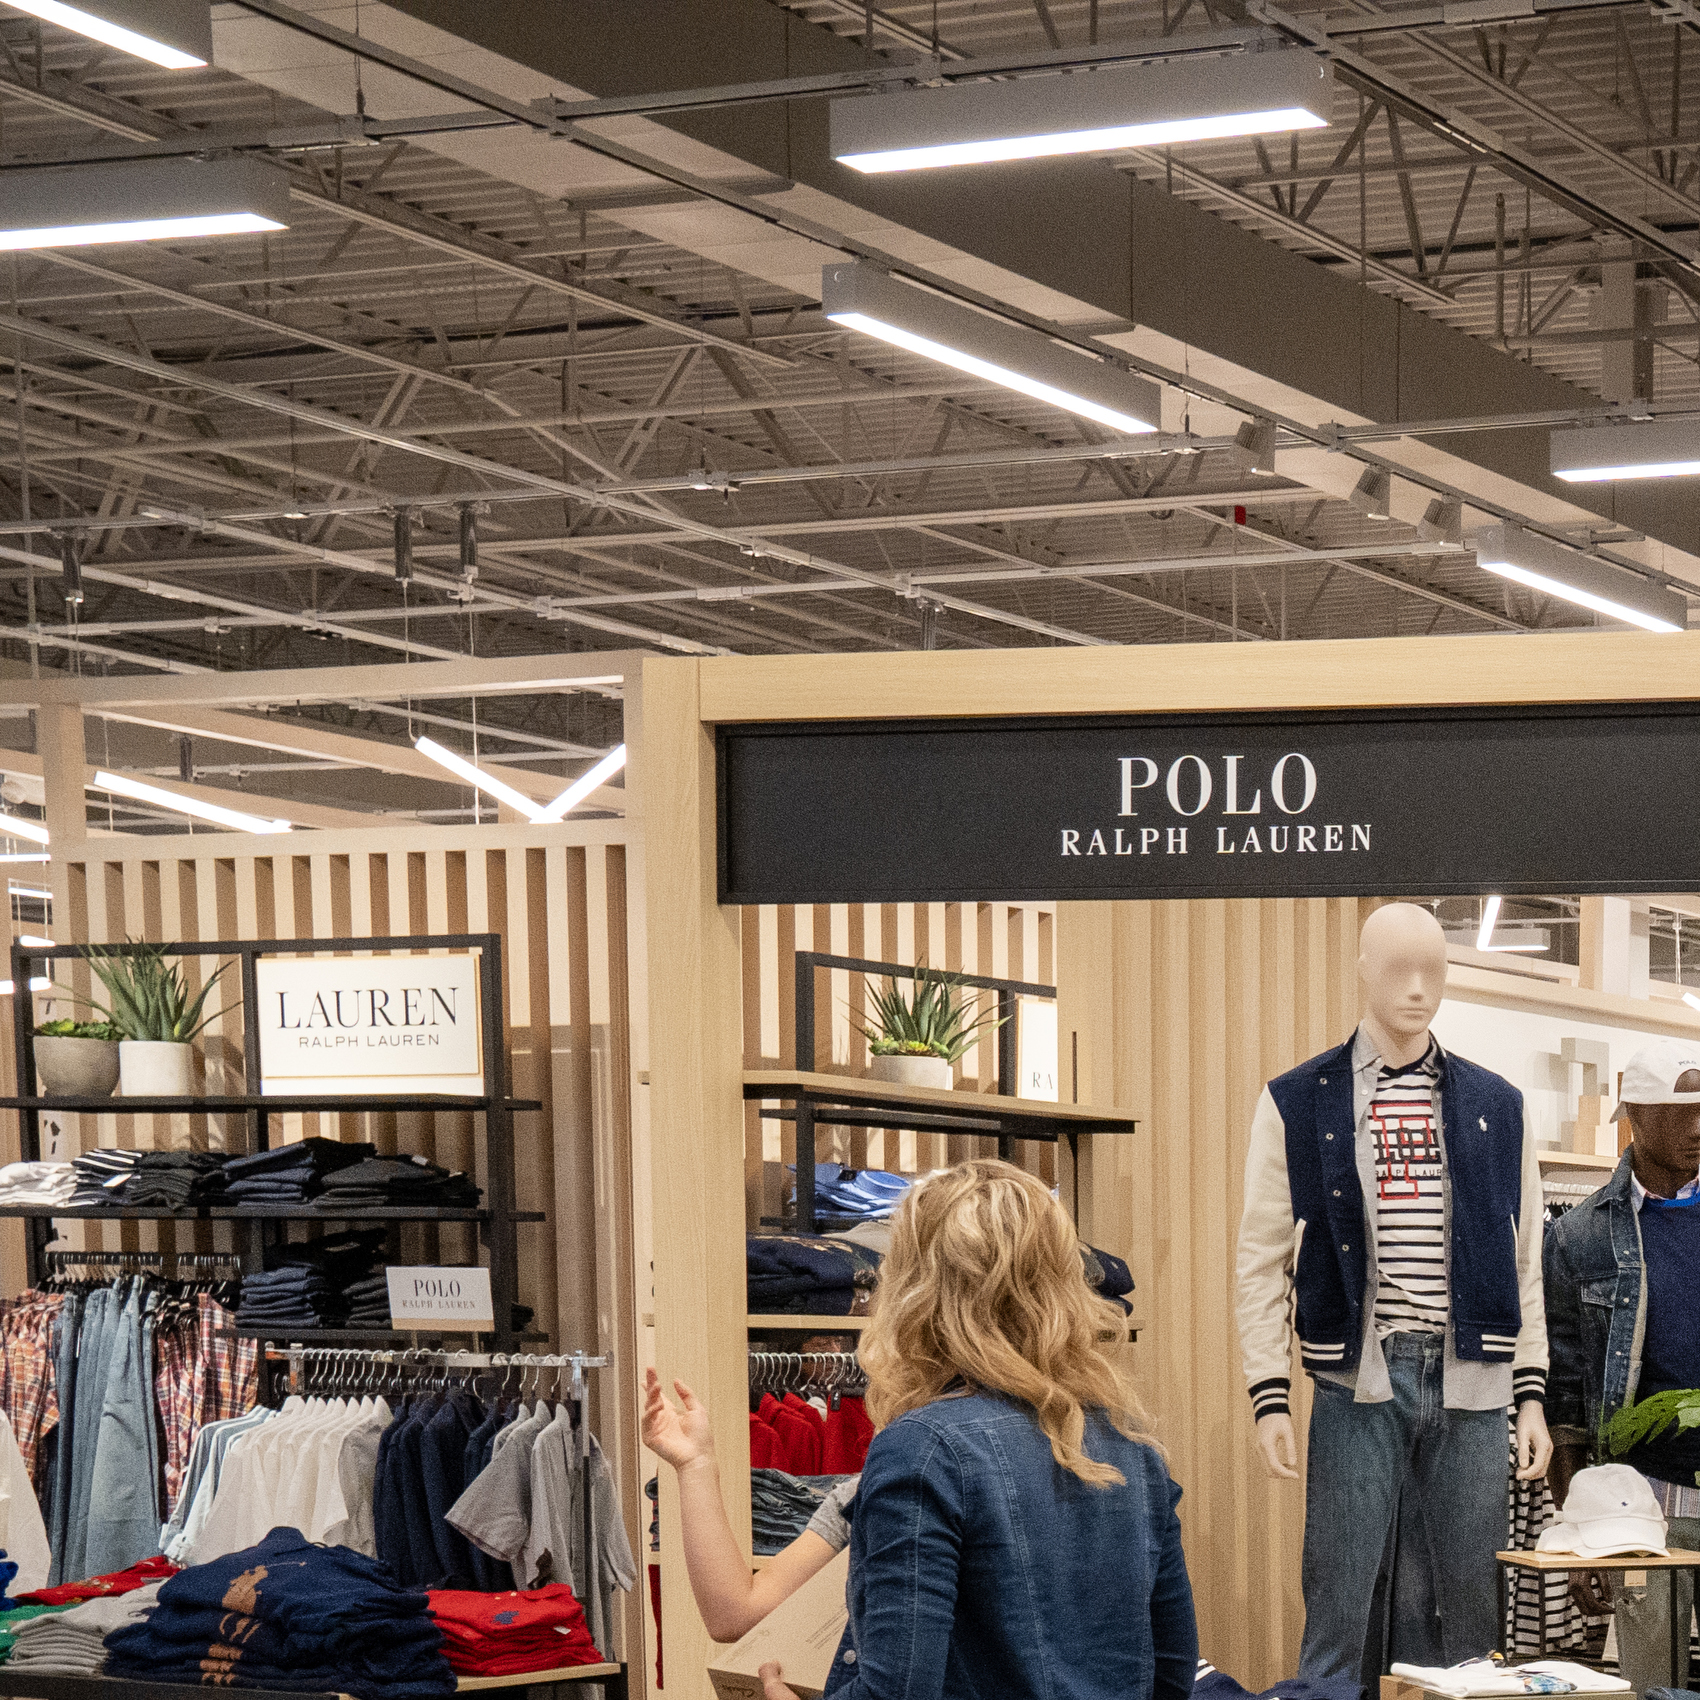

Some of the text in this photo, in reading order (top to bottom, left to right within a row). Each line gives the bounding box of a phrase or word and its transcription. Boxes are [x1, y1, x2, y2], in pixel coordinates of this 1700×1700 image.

[1117, 753, 1318, 816] POLO
[1061, 824, 1372, 856] RALPH LAUREN
[276, 987, 458, 1029] LAUREN
[299, 1034, 440, 1048] RALPH LAUREN
[414, 1279, 461, 1298] POLO
[402, 1300, 476, 1309] RALPH LAUREN
